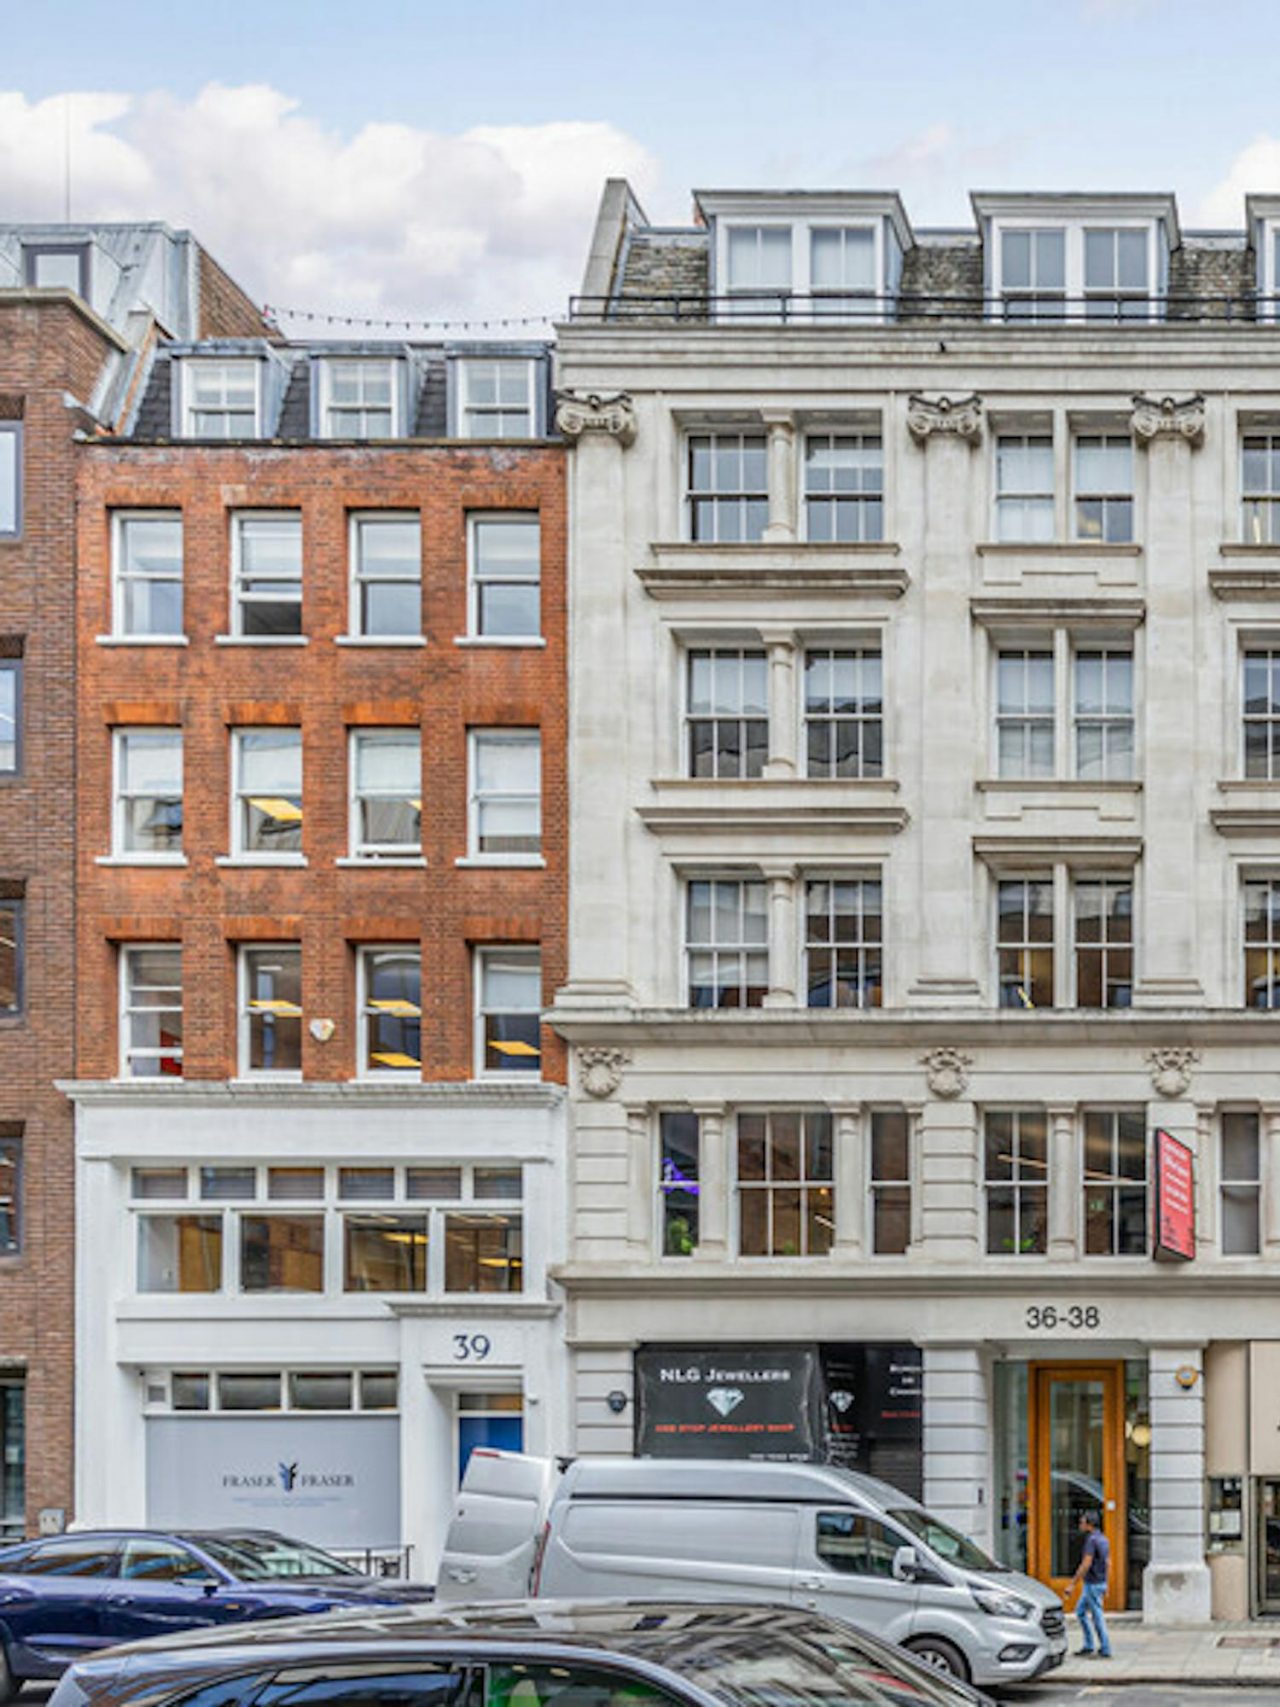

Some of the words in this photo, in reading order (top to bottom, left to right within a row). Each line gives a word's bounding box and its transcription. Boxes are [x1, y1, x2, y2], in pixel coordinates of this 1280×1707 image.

[1027, 1306, 1099, 1329] 36-38
[453, 1335, 490, 1360] 39
[660, 1368, 700, 1382] NLG
[223, 1475, 275, 1487] FRASER
[301, 1475, 354, 1487] FRASER
